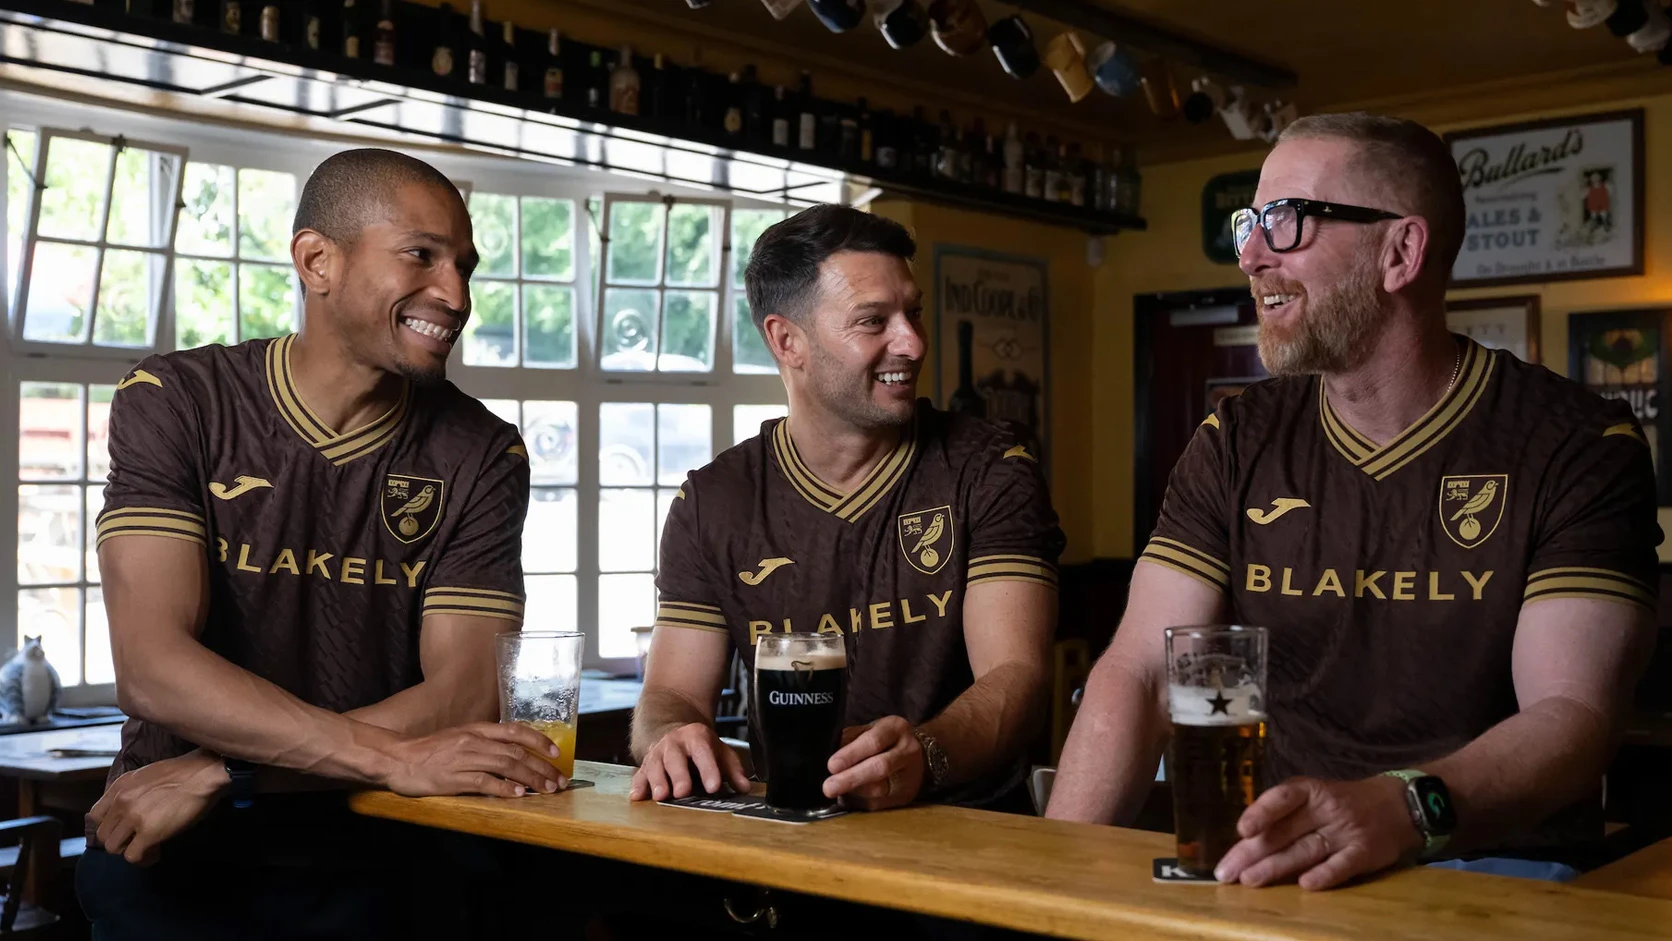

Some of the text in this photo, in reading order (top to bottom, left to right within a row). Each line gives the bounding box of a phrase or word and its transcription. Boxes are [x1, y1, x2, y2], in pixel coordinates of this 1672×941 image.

[1459, 129, 1583, 190] Bullard's
[1467, 206, 1542, 228] ALES &
[1466, 229, 1540, 252] STOUT
[1246, 563, 1494, 600] BLAKELY
[769, 690, 834, 705] GUINNESS
